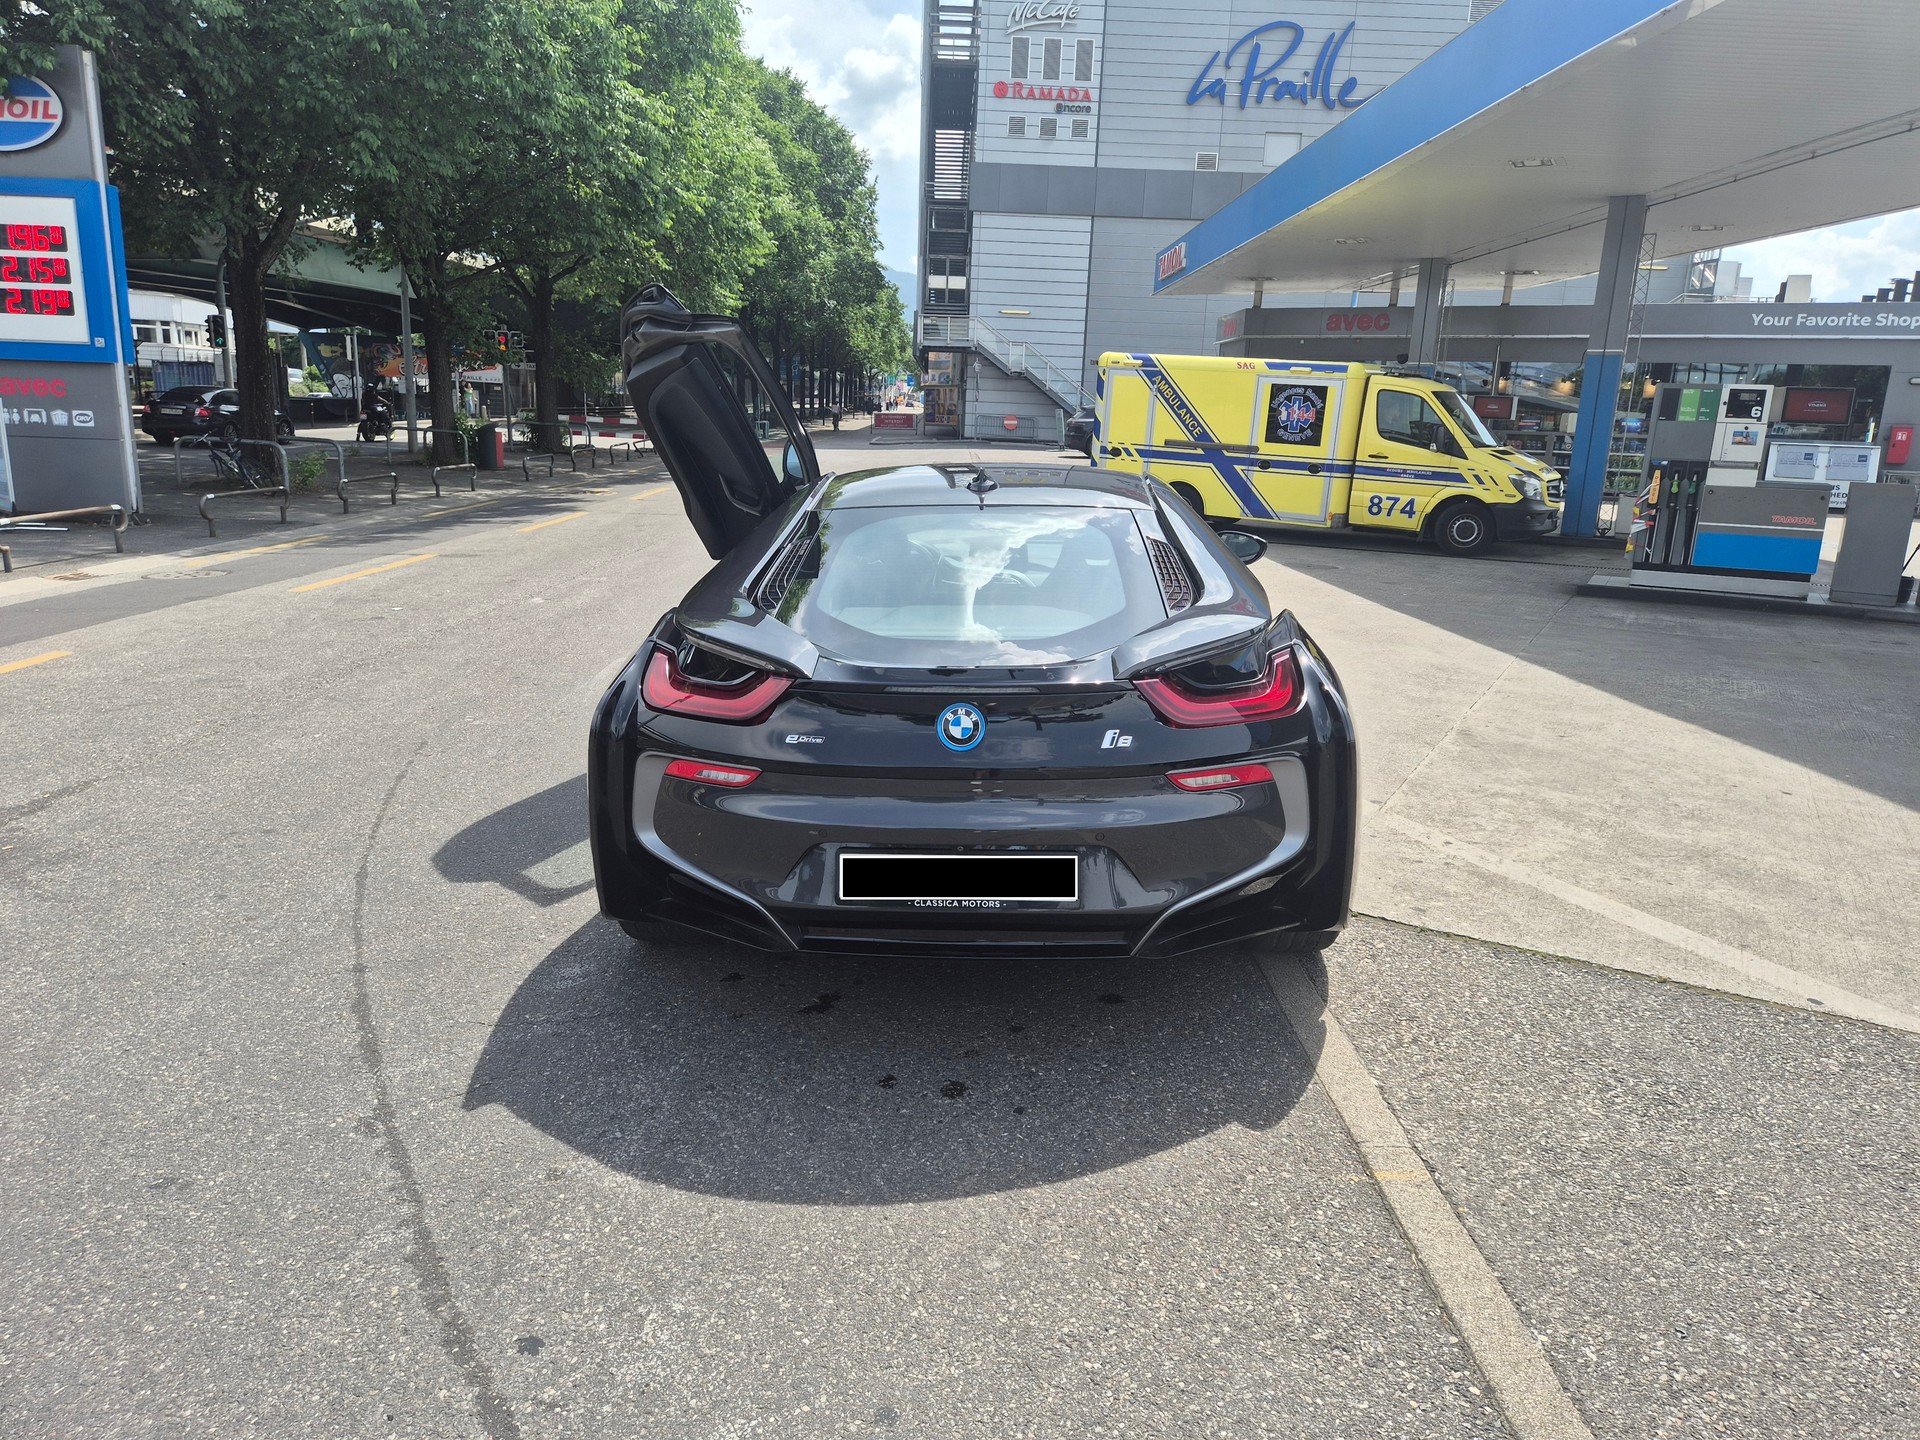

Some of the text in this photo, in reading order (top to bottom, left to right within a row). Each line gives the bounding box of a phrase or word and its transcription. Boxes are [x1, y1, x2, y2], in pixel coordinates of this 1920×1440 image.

[1186, 20, 1389, 110] La Praille
[1012, 81, 1093, 103] RAMADA
[1055, 102, 1092, 114] encore
[1158, 241, 1187, 281] TAMOIL
[1326, 313, 1391, 332] avec
[1751, 312, 1920, 330] Your Favorite Shop
[1236, 361, 1256, 370] SAG
[0, 377, 68, 397] avec
[1152, 375, 1203, 438] AMBULANCE
[1289, 407, 1317, 423] 144
[1751, 406, 1763, 418] 6
[1367, 494, 1417, 519] 874
[1771, 515, 1817, 526] TAMOIL
[1101, 729, 1133, 748] i8
[914, 899, 1001, 908] CLASSICA MOTORS
